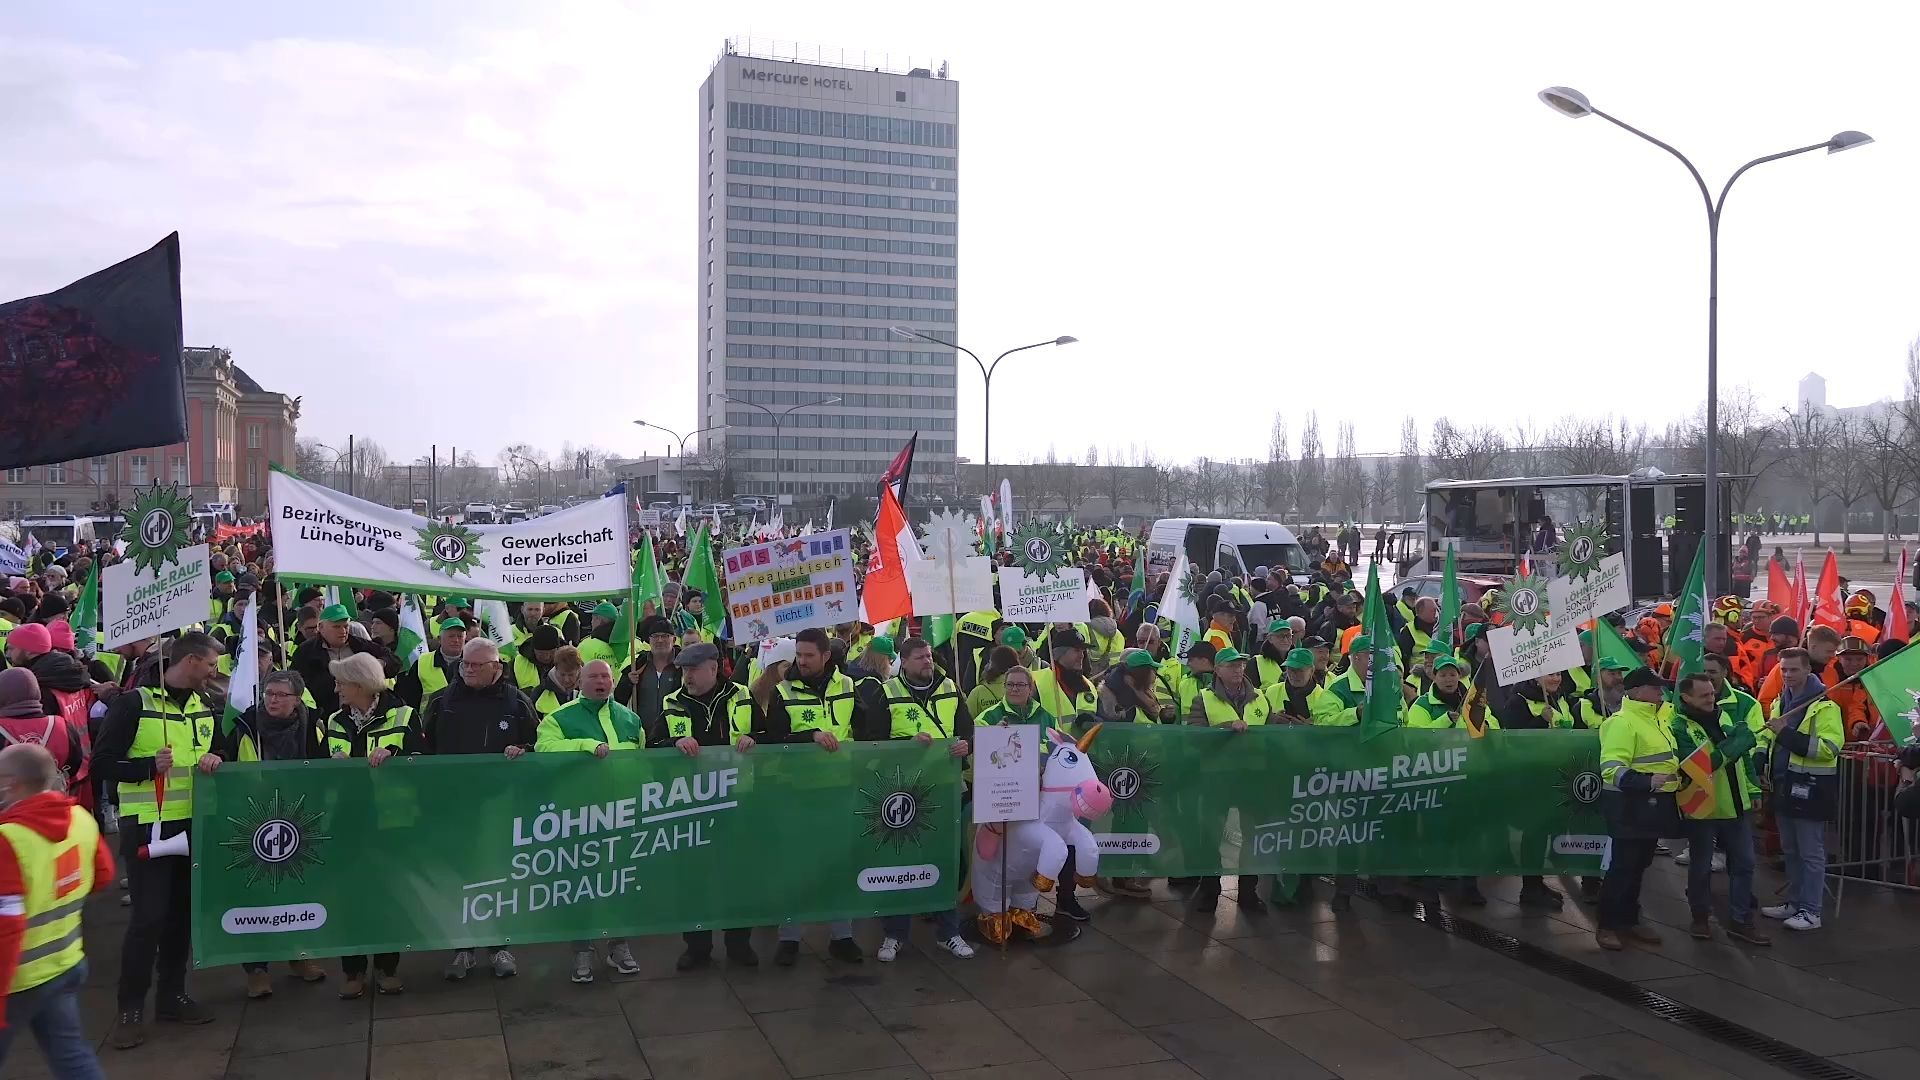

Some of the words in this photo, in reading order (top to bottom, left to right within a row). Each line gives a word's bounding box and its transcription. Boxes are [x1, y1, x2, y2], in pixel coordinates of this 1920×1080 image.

[742, 68, 809, 86] Mercure
[814, 77, 853, 91] HOTEL
[144, 512, 169, 543] GdP
[282, 505, 402, 540] Bezirksgruppe
[300, 525, 385, 552] Lüneburg
[436, 537, 461, 559] GdP
[501, 527, 614, 549] Gewerkschaft
[502, 553, 531, 566] der
[535, 549, 588, 566] Polizei
[727, 549, 768, 572] DAS
[126, 578, 168, 607] LÖHNE
[169, 559, 203, 584] RAUF
[502, 570, 595, 584] Niedersachsen
[771, 576, 809, 592] unsere
[1018, 585, 1053, 597] LÖHNE
[1052, 578, 1080, 592] RAUF
[1565, 584, 1596, 606] LÖHNE
[1595, 564, 1621, 586] RAUF
[126, 594, 164, 619] SONST
[1007, 607, 1023, 617] ICH
[1025, 603, 1057, 615] DRAUF.
[1019, 594, 1048, 606] SONST
[1565, 593, 1592, 615] SONST
[110, 621, 130, 641] ICH
[132, 604, 171, 634] DRAUF.
[775, 609, 802, 623] nicht
[1555, 615, 1570, 630] ICH
[1572, 599, 1600, 622] DRAUF.
[1510, 637, 1544, 657] LÖHNE
[1511, 648, 1541, 666] SONST
[1502, 666, 1518, 680] ICH
[1519, 655, 1550, 673] DRAUF.
[1111, 771, 1136, 795] GdP
[1292, 767, 1389, 799] LÖHNE
[1392, 747, 1468, 779] RAUF
[1576, 775, 1598, 801] GdP
[511, 797, 637, 847] LÖHNE
[641, 767, 739, 812] RAUF
[886, 796, 911, 824] GdP
[1288, 795, 1375, 824] SONST
[258, 824, 293, 857] GdP
[1096, 838, 1153, 850] www.gdp.de
[1253, 829, 1294, 856] ICH
[1300, 819, 1386, 849] DRAUF.
[510, 835, 622, 881] SONST
[867, 870, 931, 884] www.gdp.de
[461, 887, 519, 924] ICH
[528, 866, 642, 912] DRAUF.
[234, 910, 316, 926] www.gdp.de
